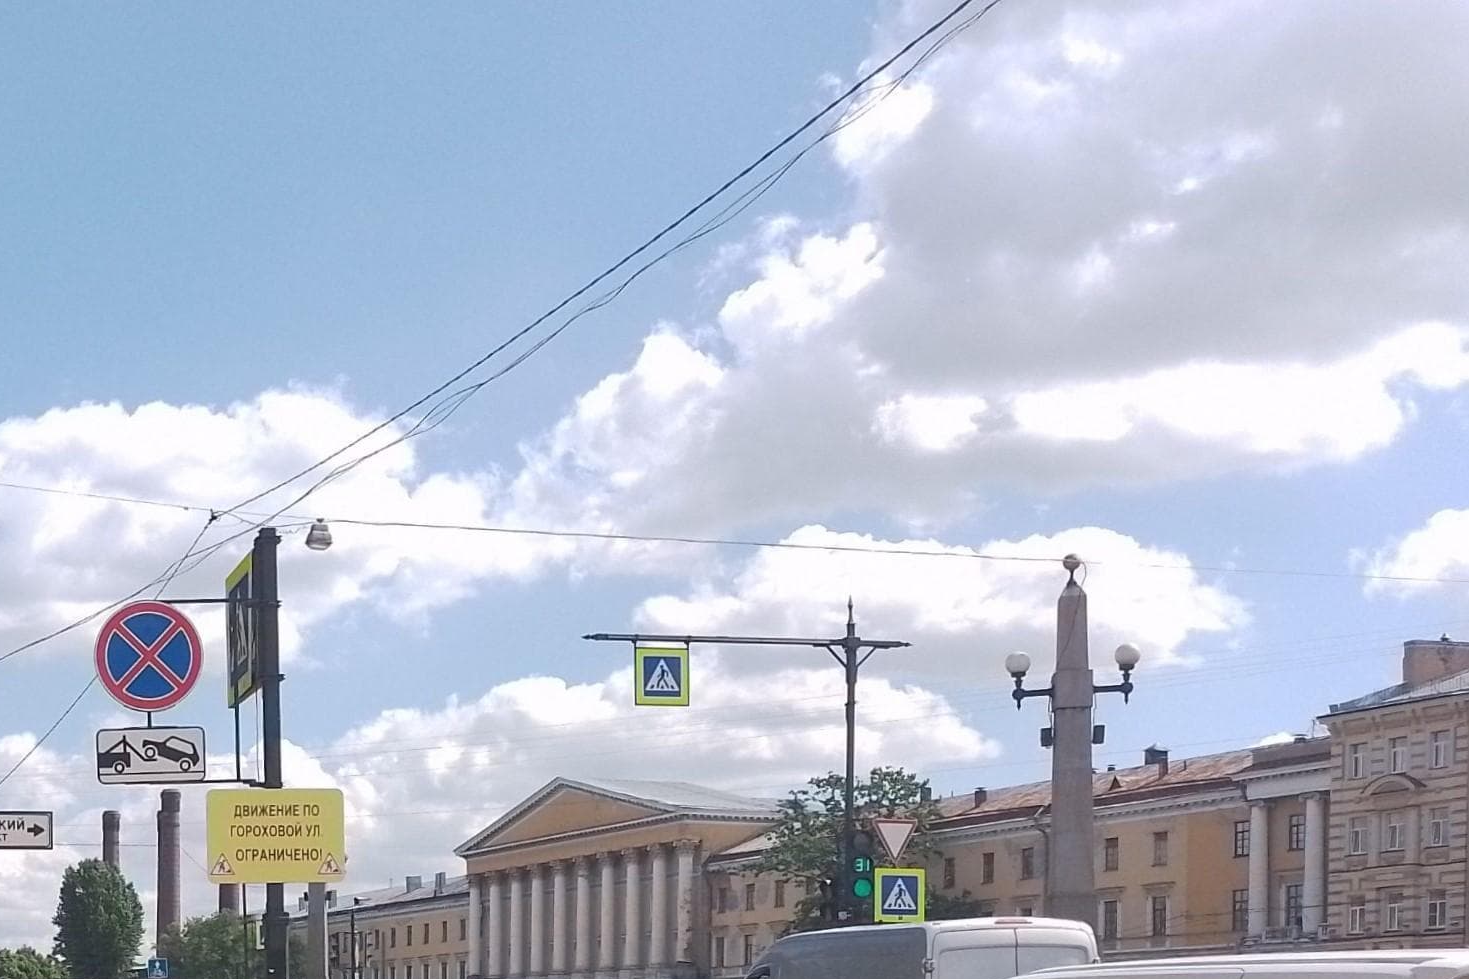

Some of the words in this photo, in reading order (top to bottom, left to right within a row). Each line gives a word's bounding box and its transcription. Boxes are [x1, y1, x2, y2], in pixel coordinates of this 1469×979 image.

[234, 804, 299, 819] ДВИЖЕНИЕ
[303, 804, 320, 817] ПО
[230, 823, 302, 838] ГОРОХОВОЙ
[235, 848, 322, 862] ОГРАНИЧЕНО!
[855, 858, 870, 872] 31
